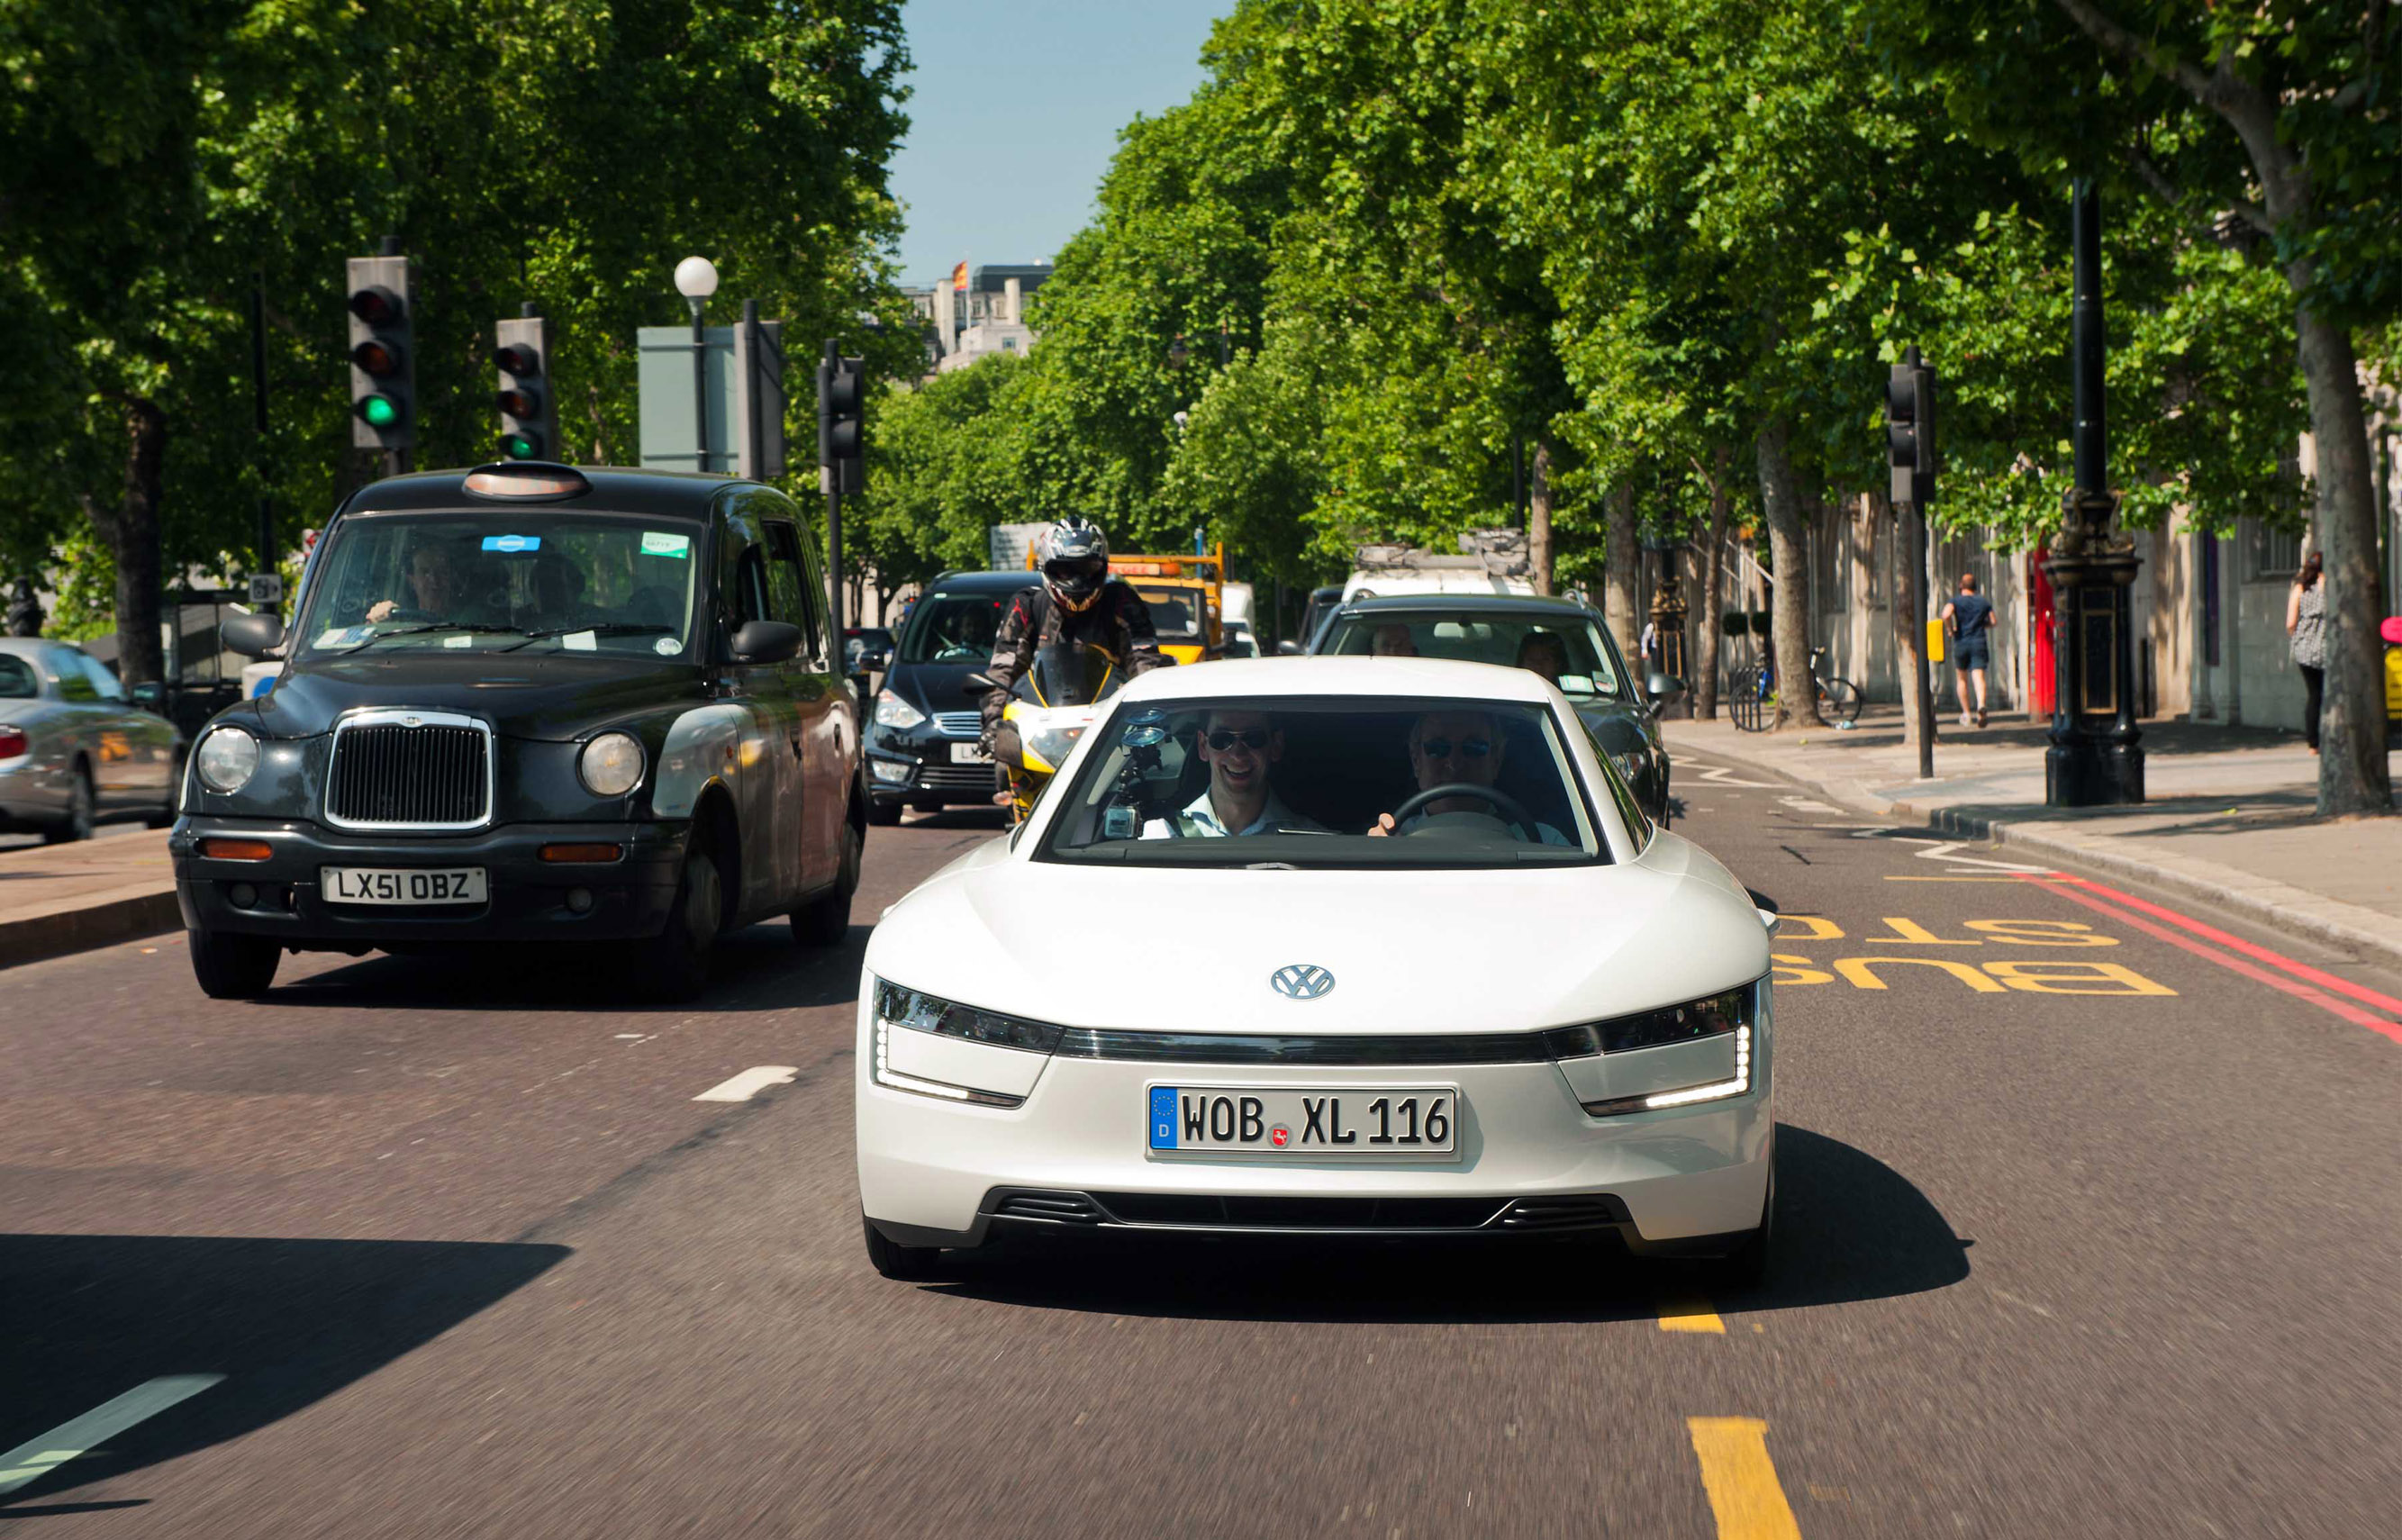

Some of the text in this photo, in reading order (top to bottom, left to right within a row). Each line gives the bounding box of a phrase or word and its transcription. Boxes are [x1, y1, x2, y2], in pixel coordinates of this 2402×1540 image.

[337, 872, 469, 900] LX51 OBZ
[1774, 915, 2121, 947] STO
[1158, 1124, 1170, 1137] D
[1181, 1095, 1449, 1145] WOB XL 116
